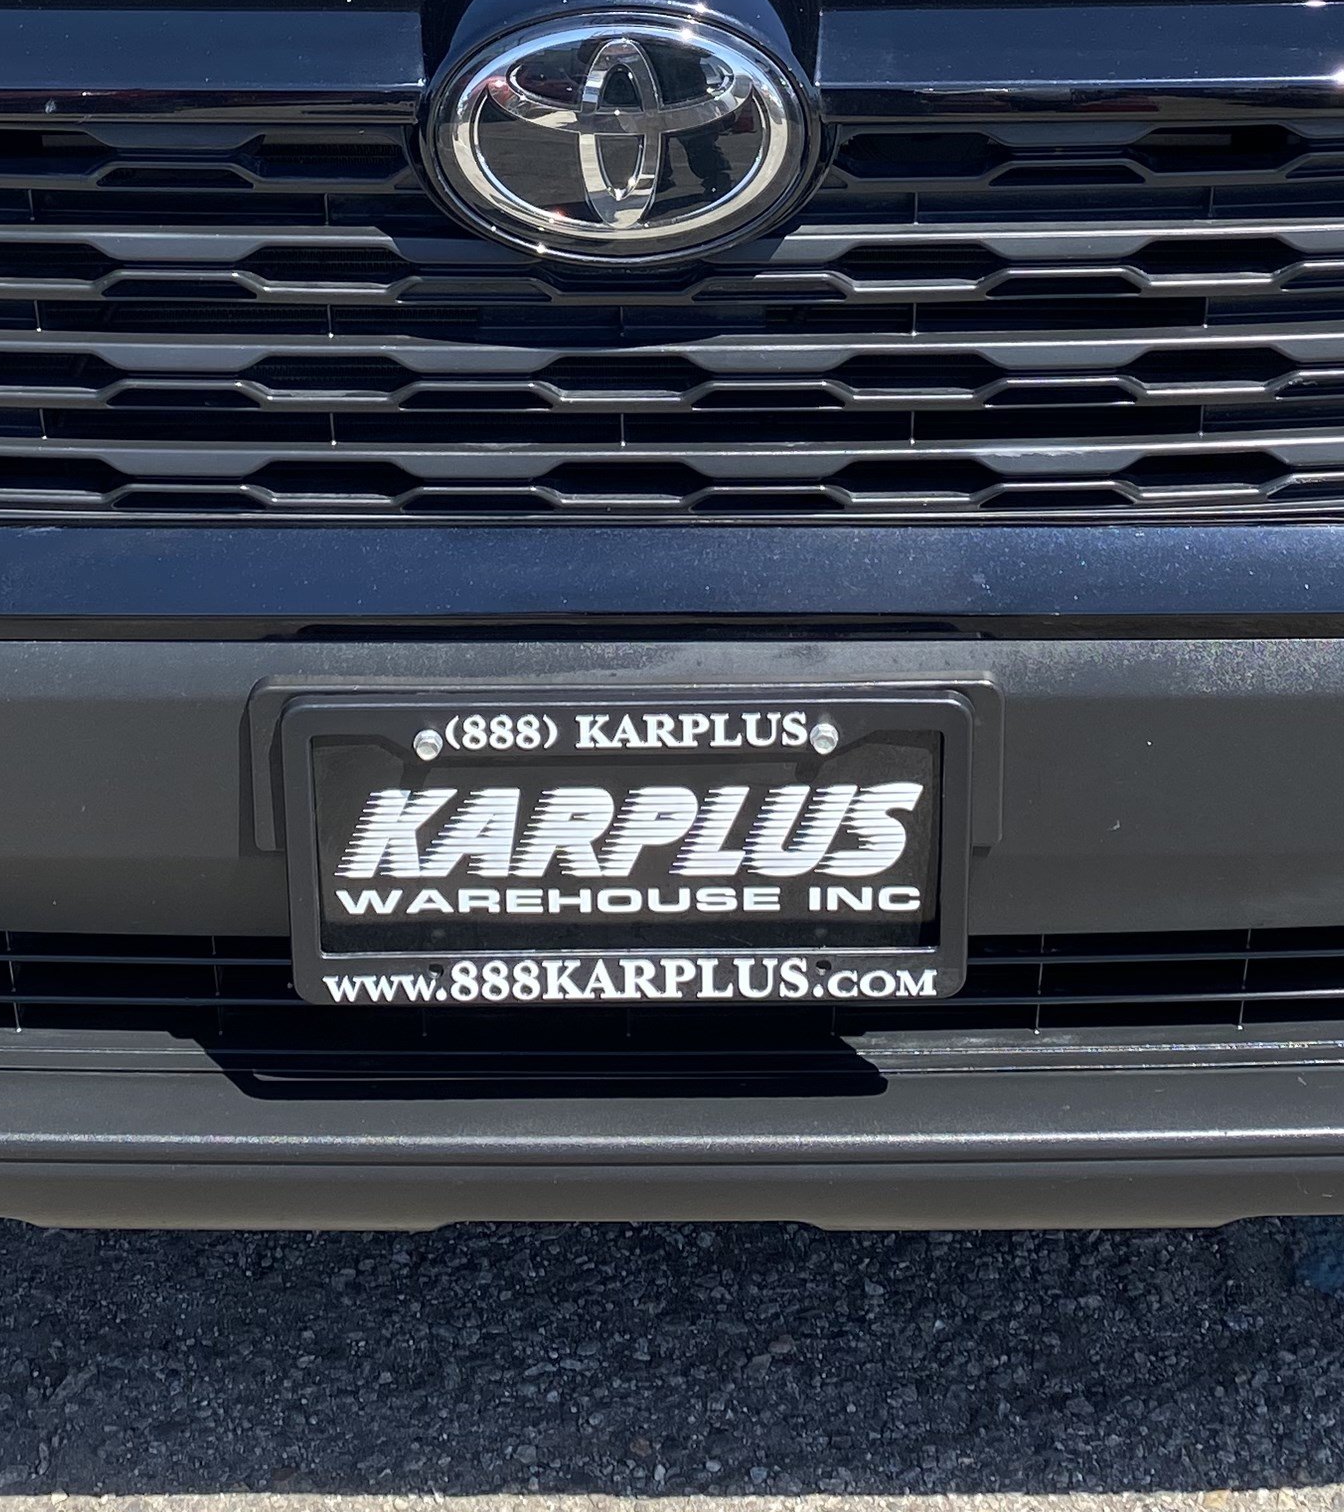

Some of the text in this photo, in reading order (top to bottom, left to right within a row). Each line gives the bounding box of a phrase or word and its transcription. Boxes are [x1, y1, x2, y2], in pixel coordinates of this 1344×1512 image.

[444, 711, 808, 750] (888) KARPLUS
[333, 782, 924, 878] KARPLUS
[334, 885, 921, 915] WAREHOUSE INC
